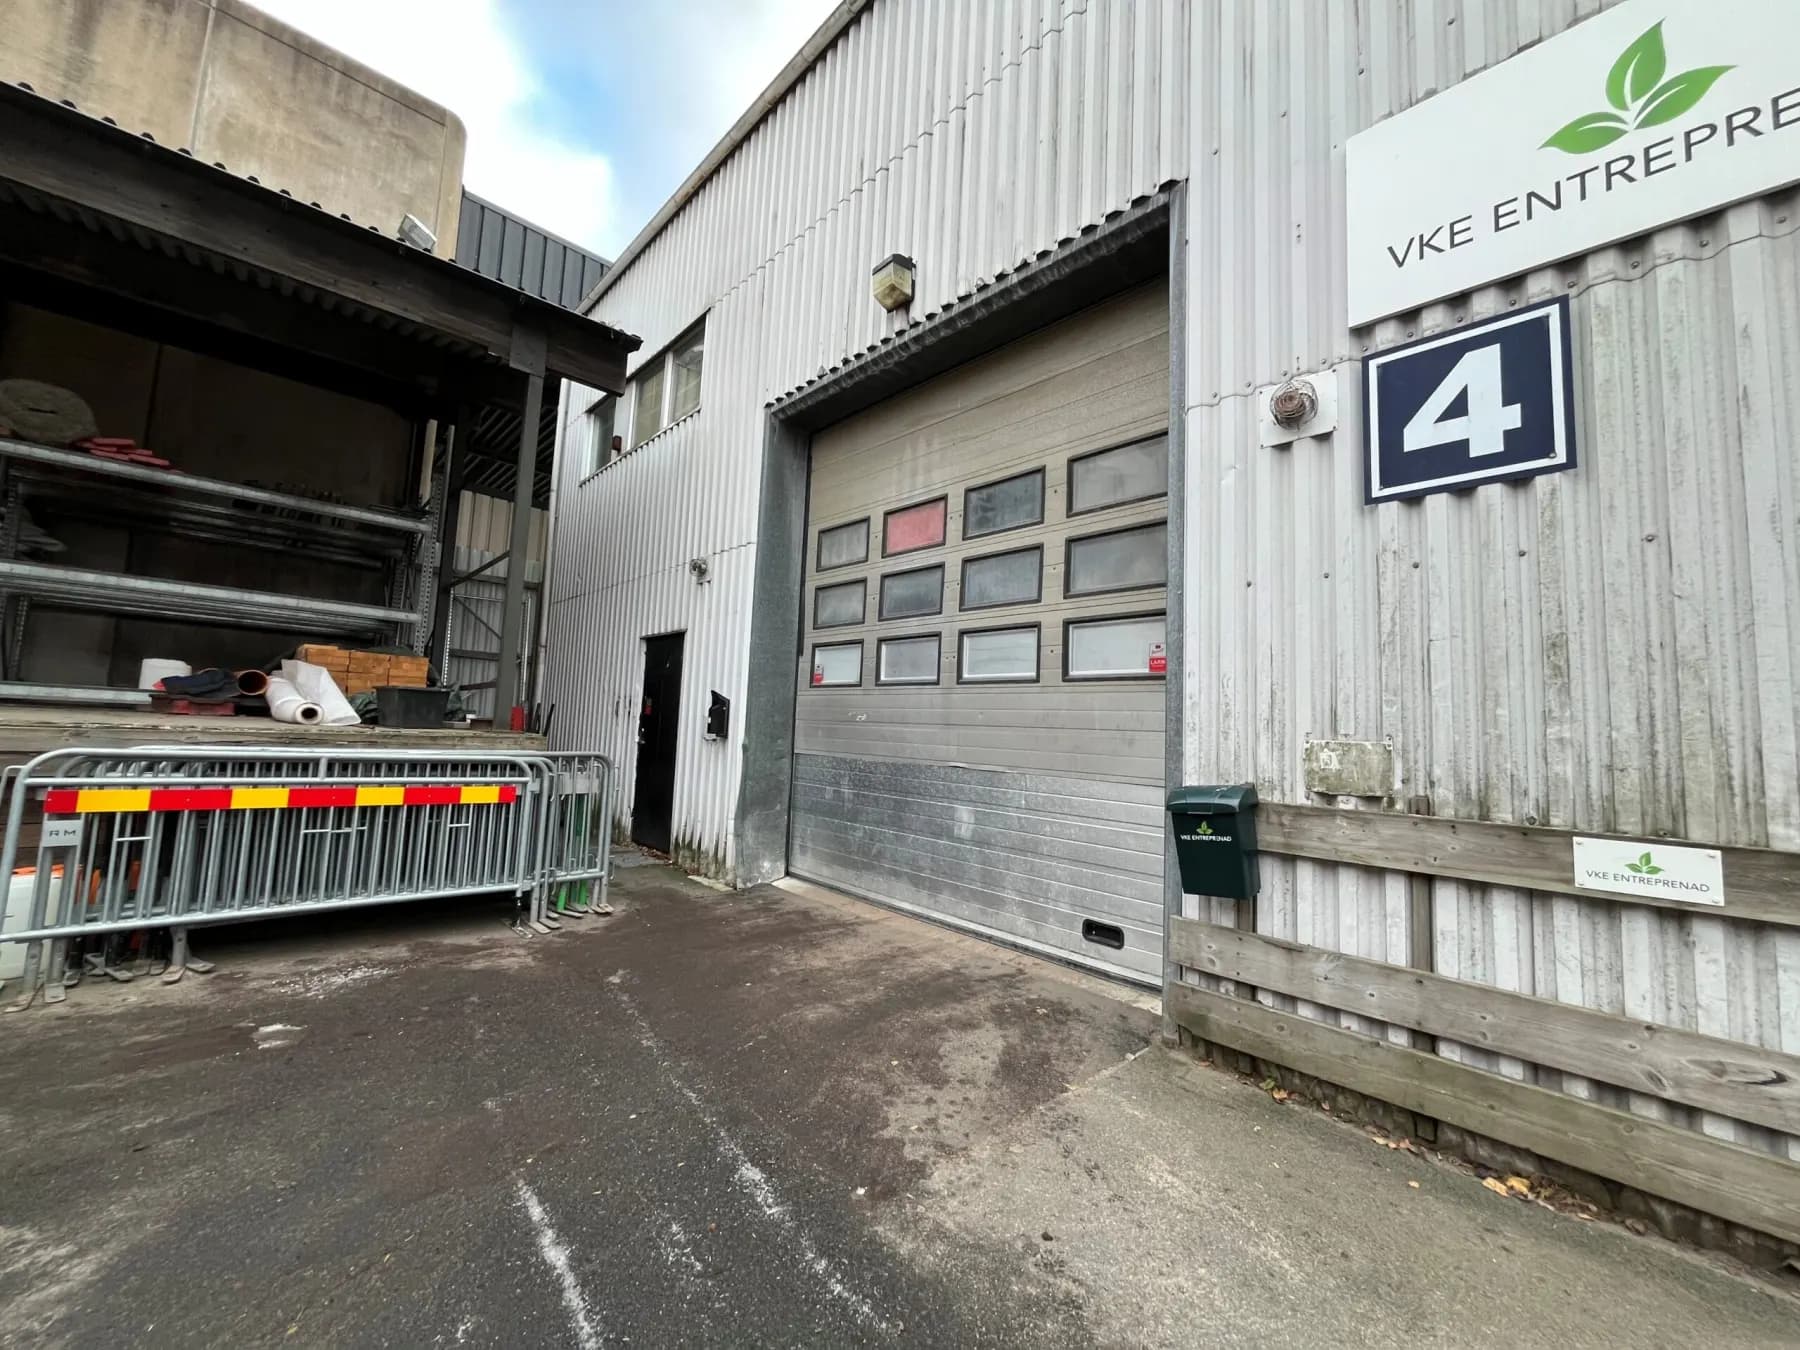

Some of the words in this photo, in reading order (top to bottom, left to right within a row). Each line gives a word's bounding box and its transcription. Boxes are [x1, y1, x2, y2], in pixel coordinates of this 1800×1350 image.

[1387, 214, 1473, 268] VKE
[1493, 87, 1800, 233] ENTREPRE
[1403, 343, 1522, 458] 4
[1586, 870, 1609, 880] VKE
[1613, 873, 1710, 892] ENTREPRENAD
